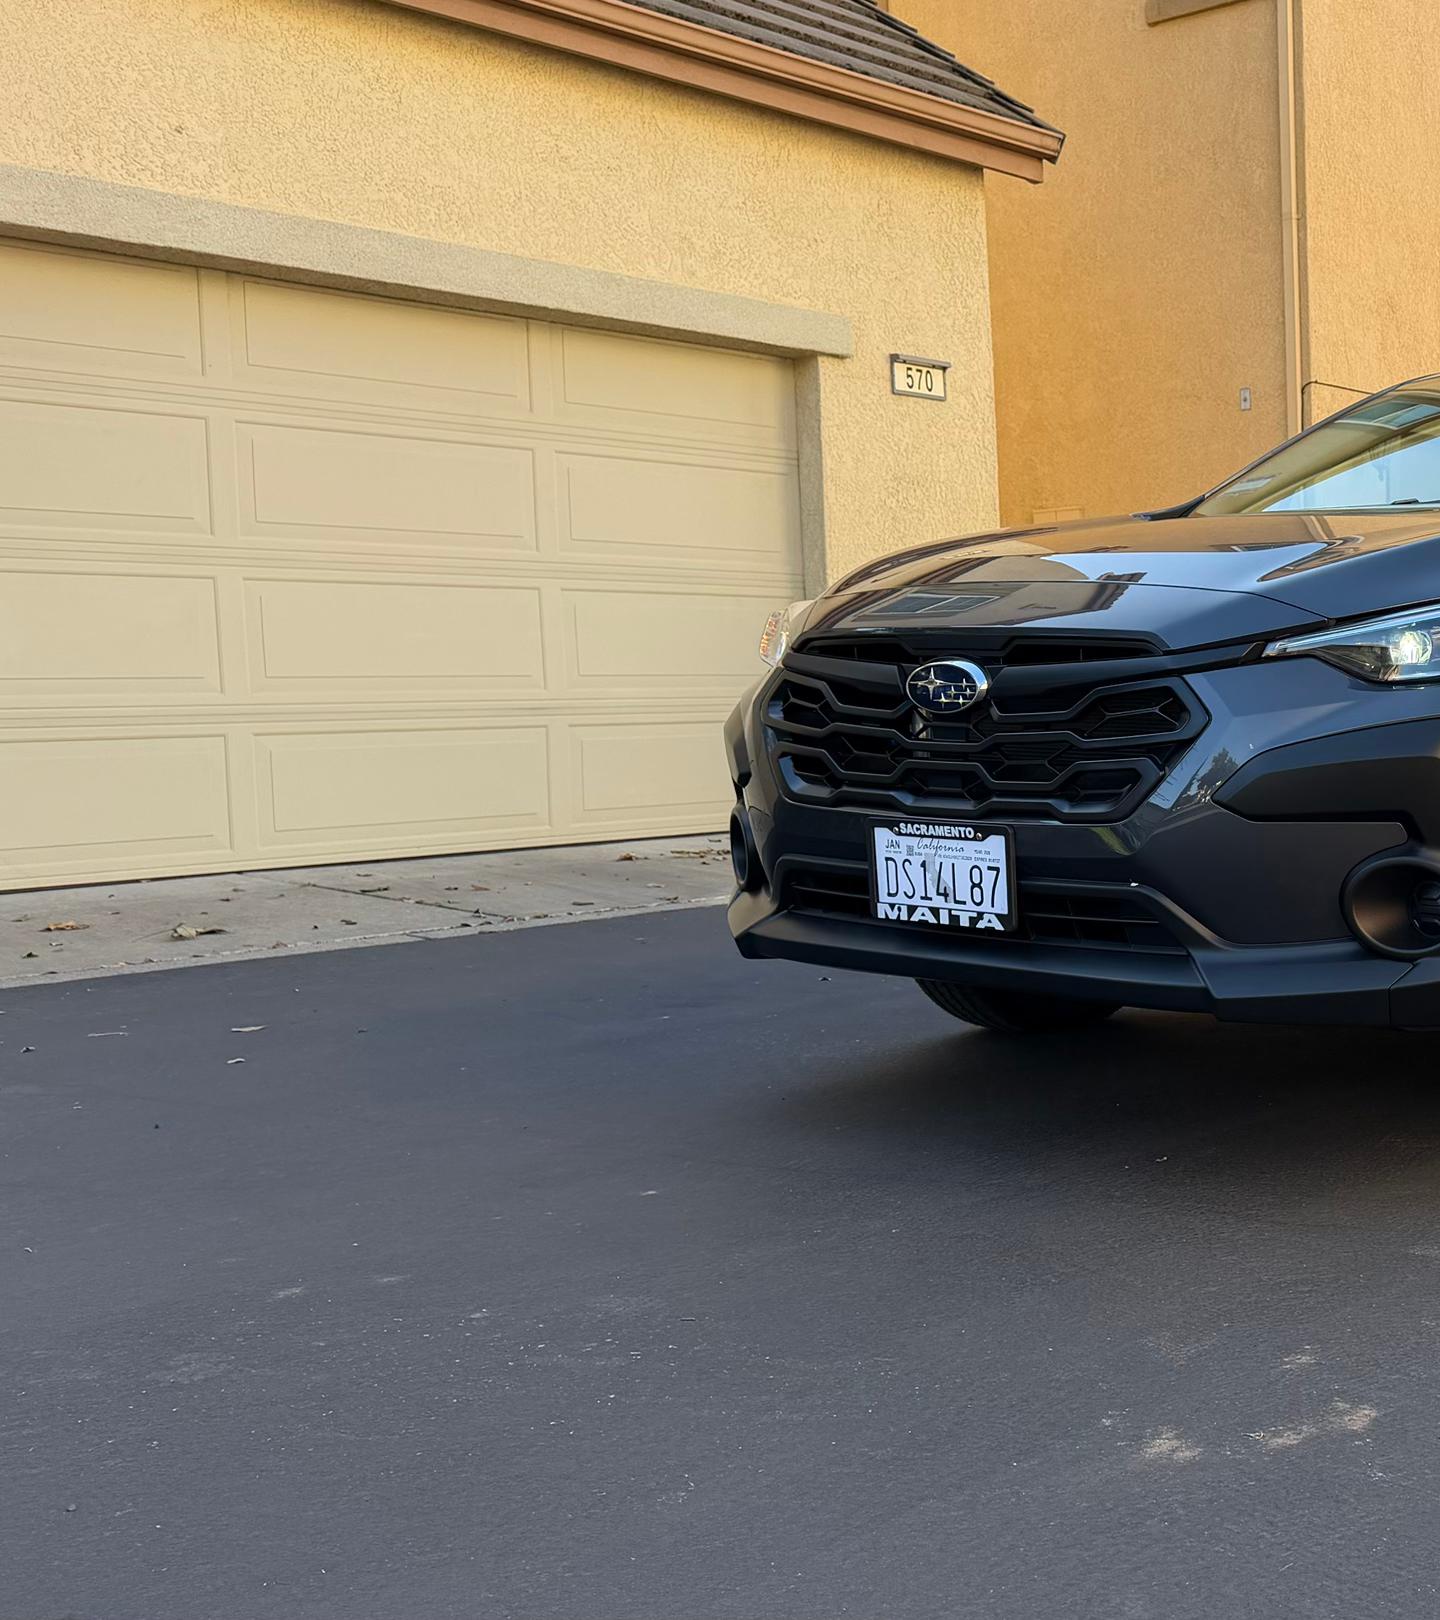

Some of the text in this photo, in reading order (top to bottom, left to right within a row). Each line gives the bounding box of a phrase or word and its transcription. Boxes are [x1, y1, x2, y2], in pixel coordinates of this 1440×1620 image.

[906, 367, 933, 392] 570
[899, 823, 975, 838] SACRAMENTO
[885, 839, 900, 849] JAN
[917, 838, 965, 856] California
[885, 857, 1001, 908] DS14L87
[877, 903, 1005, 931] MAITA
